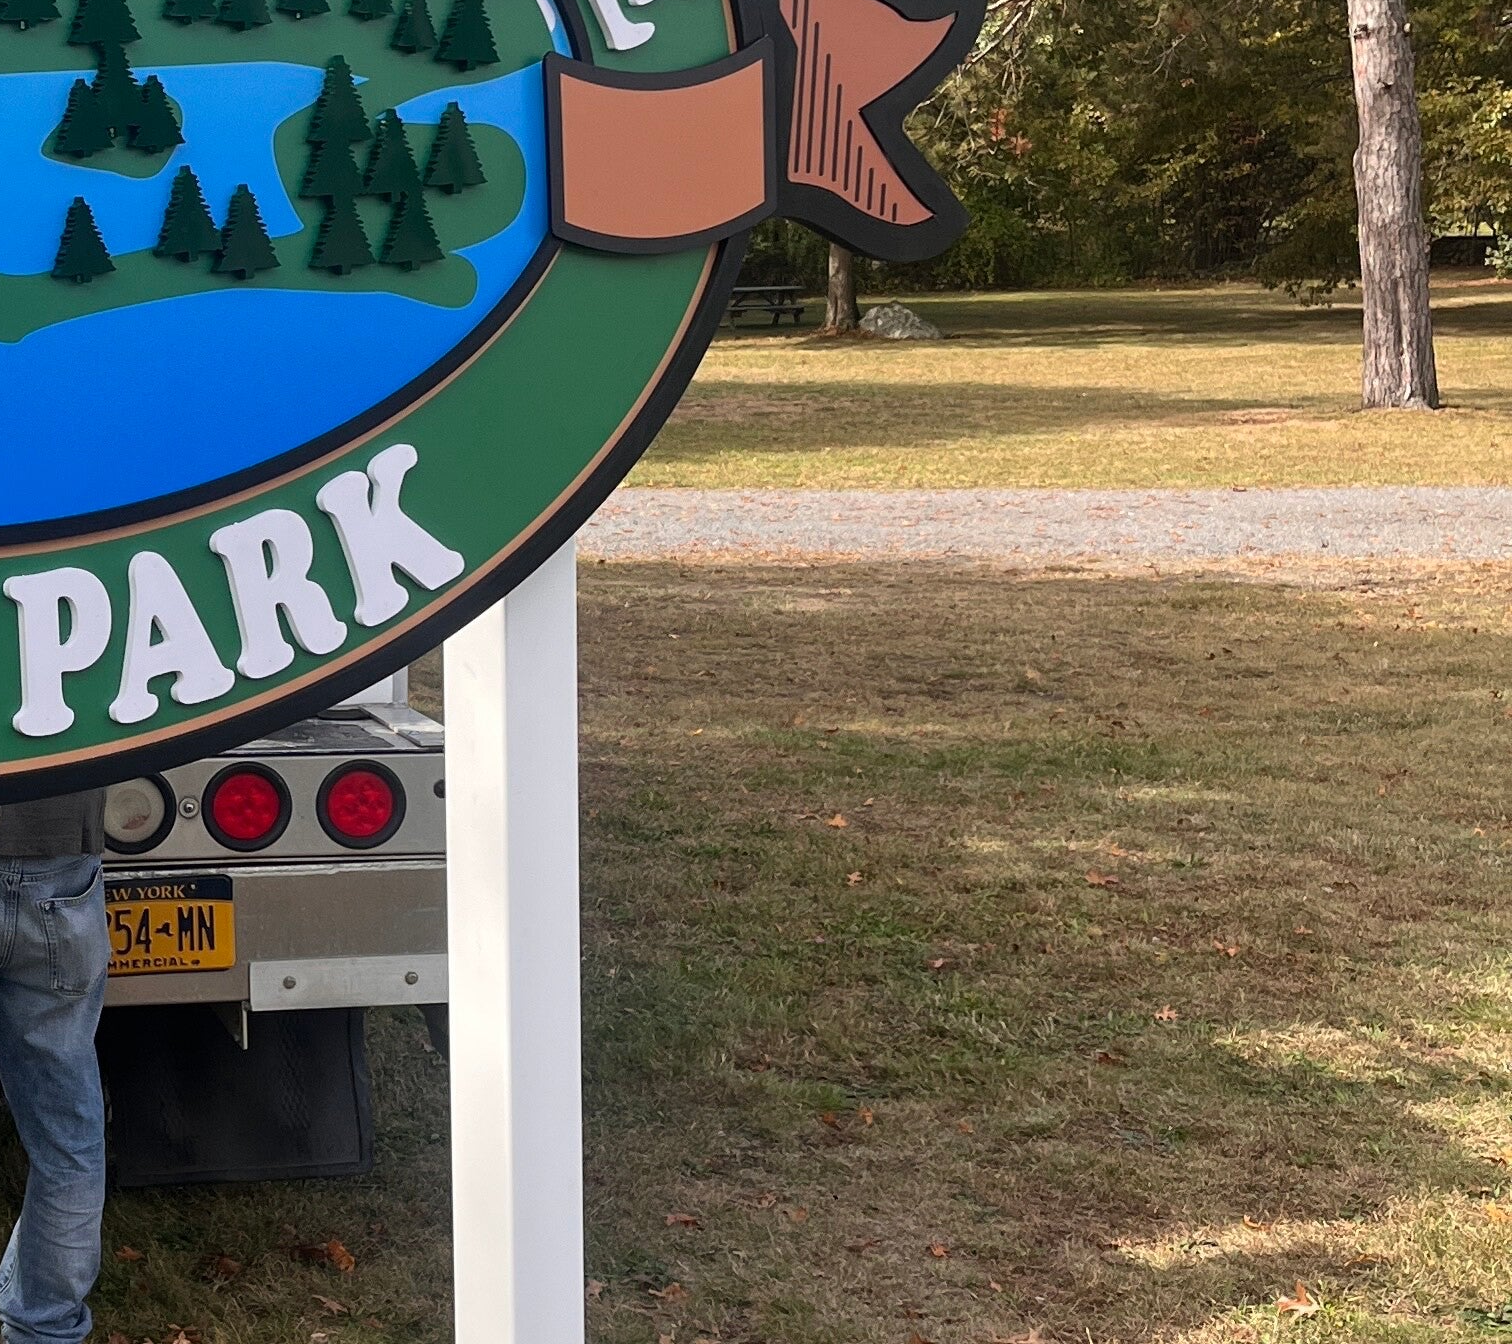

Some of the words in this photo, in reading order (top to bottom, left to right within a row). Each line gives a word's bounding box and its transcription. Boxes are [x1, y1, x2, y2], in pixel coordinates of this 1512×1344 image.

[1, 442, 466, 739] PARK
[104, 887, 133, 902] EW
[136, 884, 186, 900] YORK
[107, 956, 189, 971] MMERCIAL
